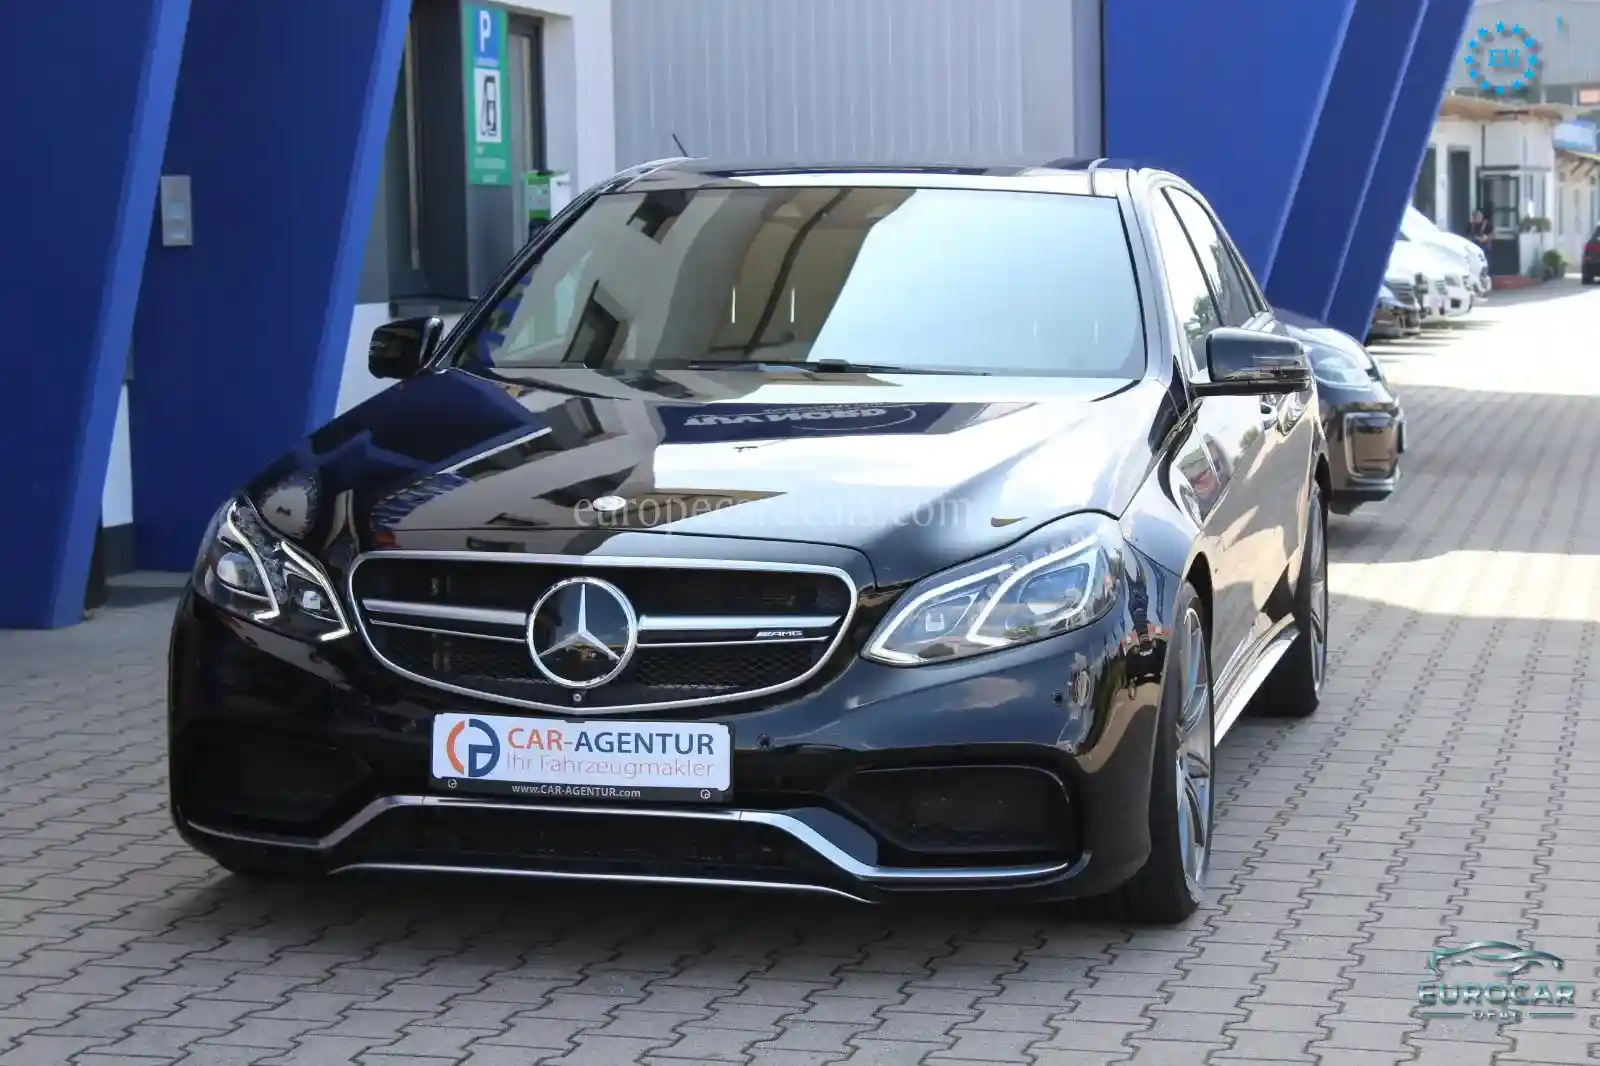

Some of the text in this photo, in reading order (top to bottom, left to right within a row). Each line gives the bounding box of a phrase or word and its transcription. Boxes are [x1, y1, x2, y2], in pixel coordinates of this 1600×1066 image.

[479, 10, 492, 52] P
[507, 727, 715, 755] CAR-AGENTUR
[507, 752, 715, 780] Ihr Fahrzeugmakler
[512, 784, 641, 799] www.CAR-AGENTUR.com
